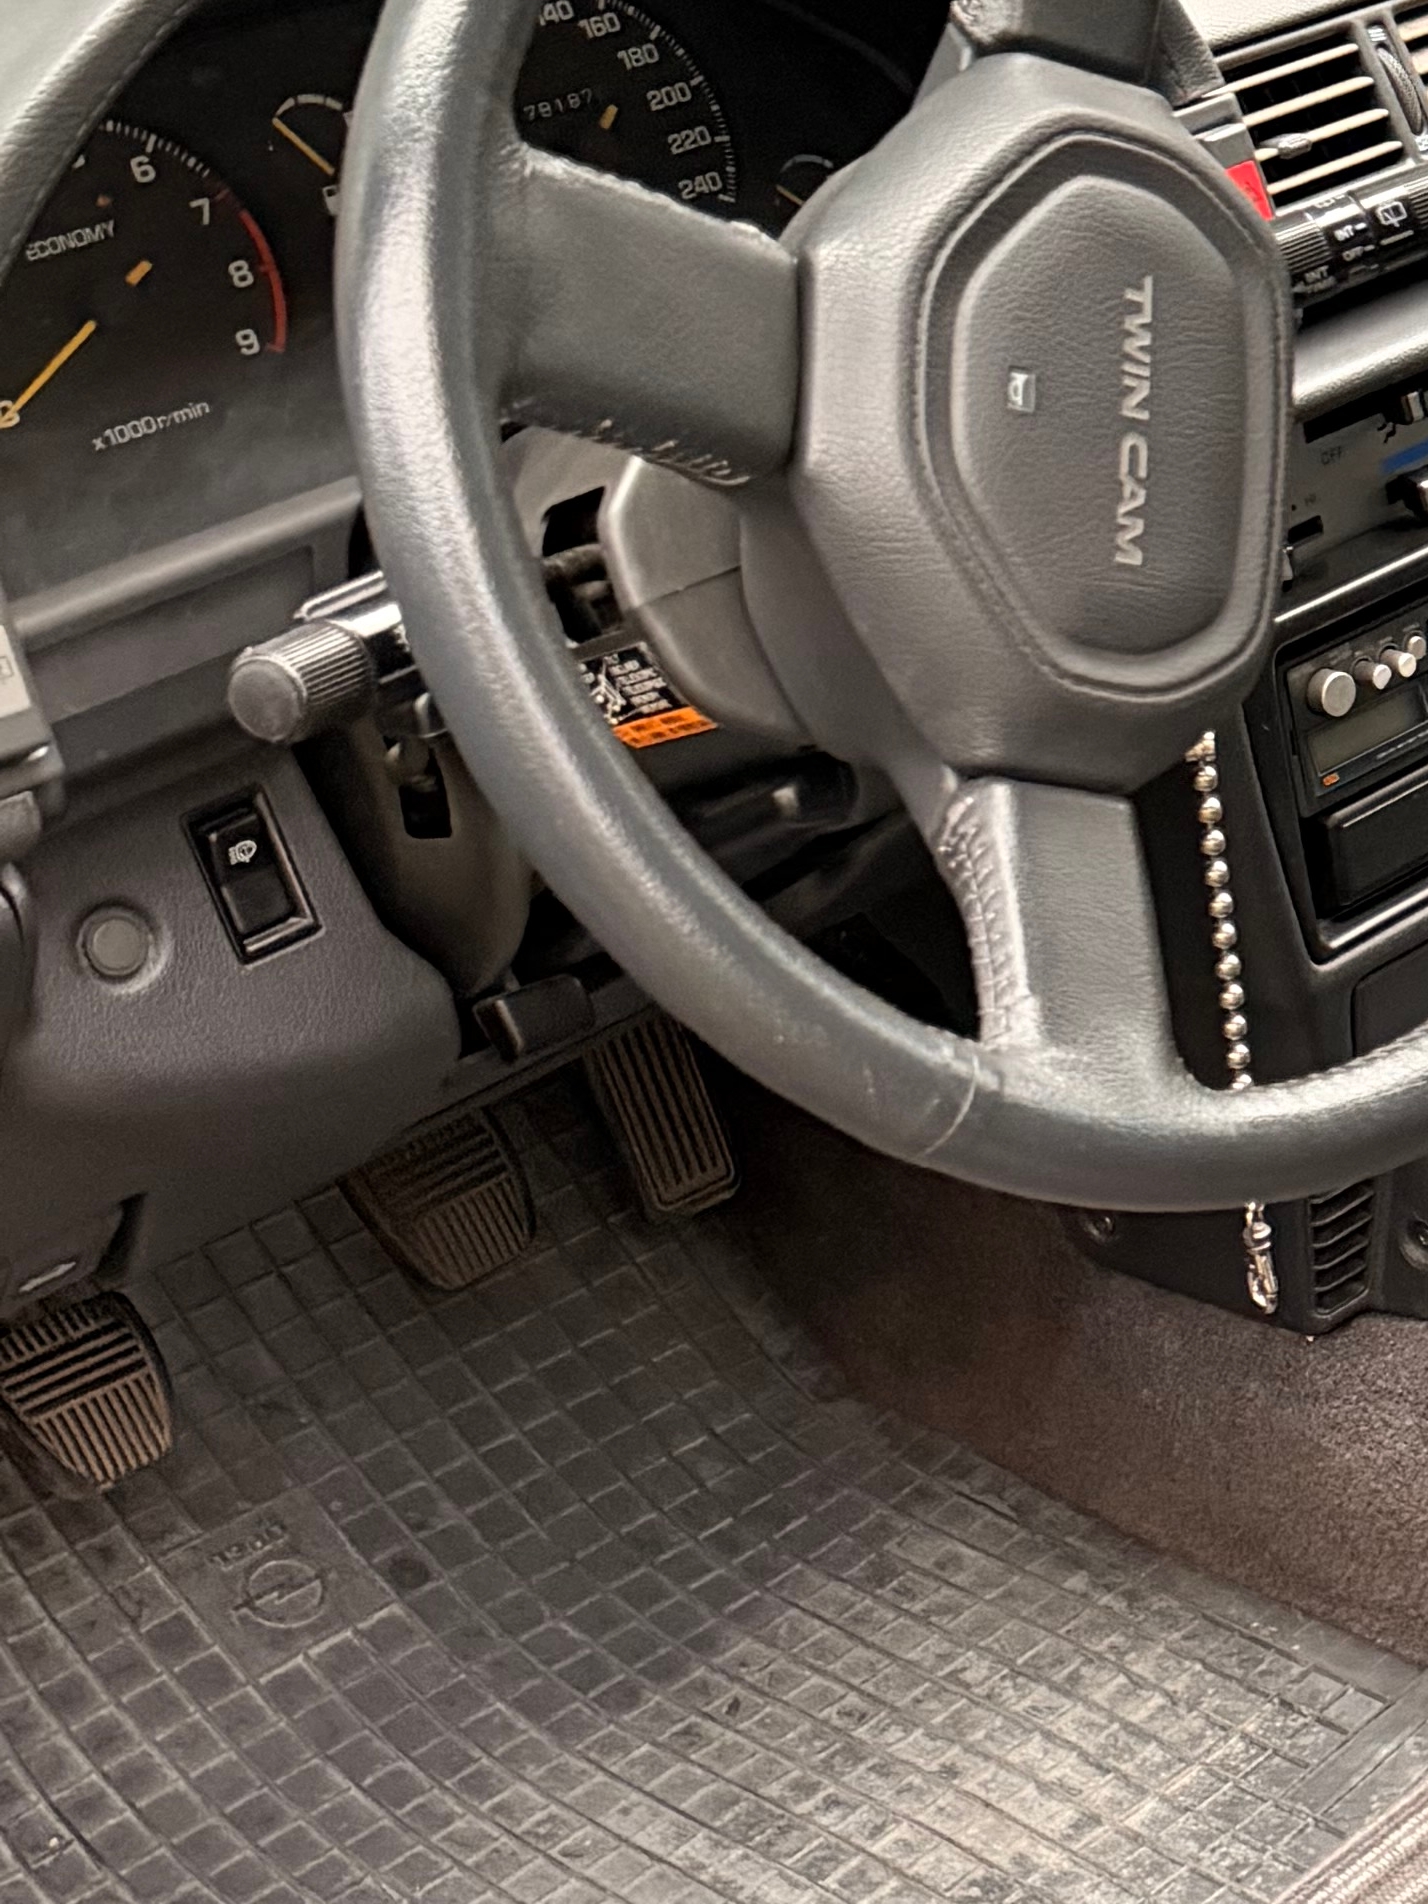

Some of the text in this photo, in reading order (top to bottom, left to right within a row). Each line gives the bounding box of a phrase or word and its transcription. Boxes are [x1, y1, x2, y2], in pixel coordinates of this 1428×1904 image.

[578, 12, 622, 39] 160
[617, 43, 660, 71] 180
[646, 81, 692, 112] 200
[667, 125, 712, 155] 220
[130, 154, 157, 184] 6
[678, 171, 723, 200] 240
[189, 197, 211, 226] 7
[25, 219, 115, 262] ECONOMY
[228, 259, 255, 288] 8
[235, 327, 261, 356] 9
[1114, 275, 1154, 565] TWIN CAM
